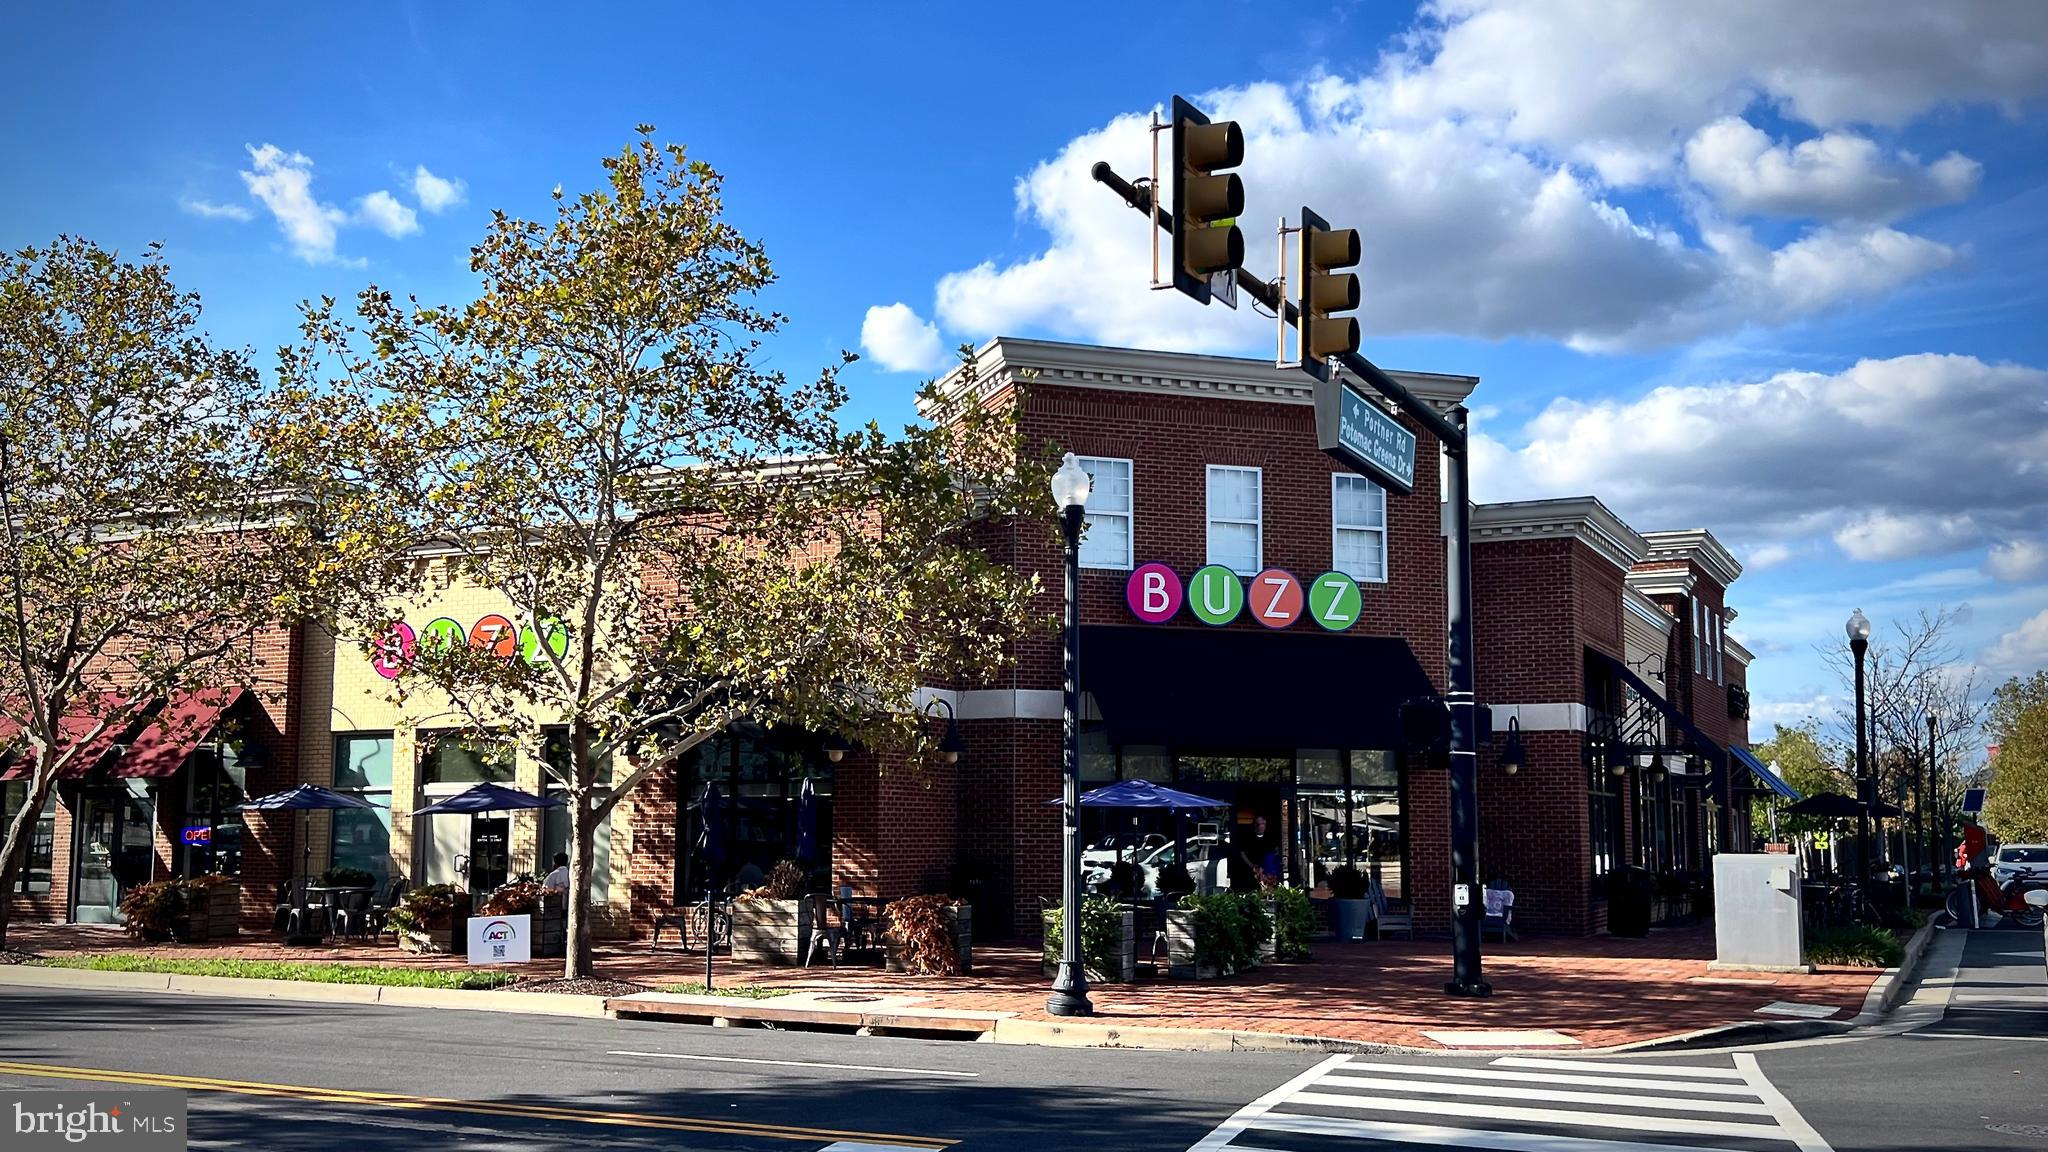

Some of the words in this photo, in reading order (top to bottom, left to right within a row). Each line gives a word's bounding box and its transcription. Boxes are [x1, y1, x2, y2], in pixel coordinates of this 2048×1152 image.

[1341, 416, 1372, 453] Potomac
[1373, 439, 1396, 469] Greens
[1397, 455, 1406, 475] Dr
[1364, 409, 1393, 444] Portner
[1396, 432, 1406, 453] Rd
[1143, 572, 1349, 621] BUZZ
[185, 830, 211, 841] OPE
[488, 931, 508, 940] ACT
